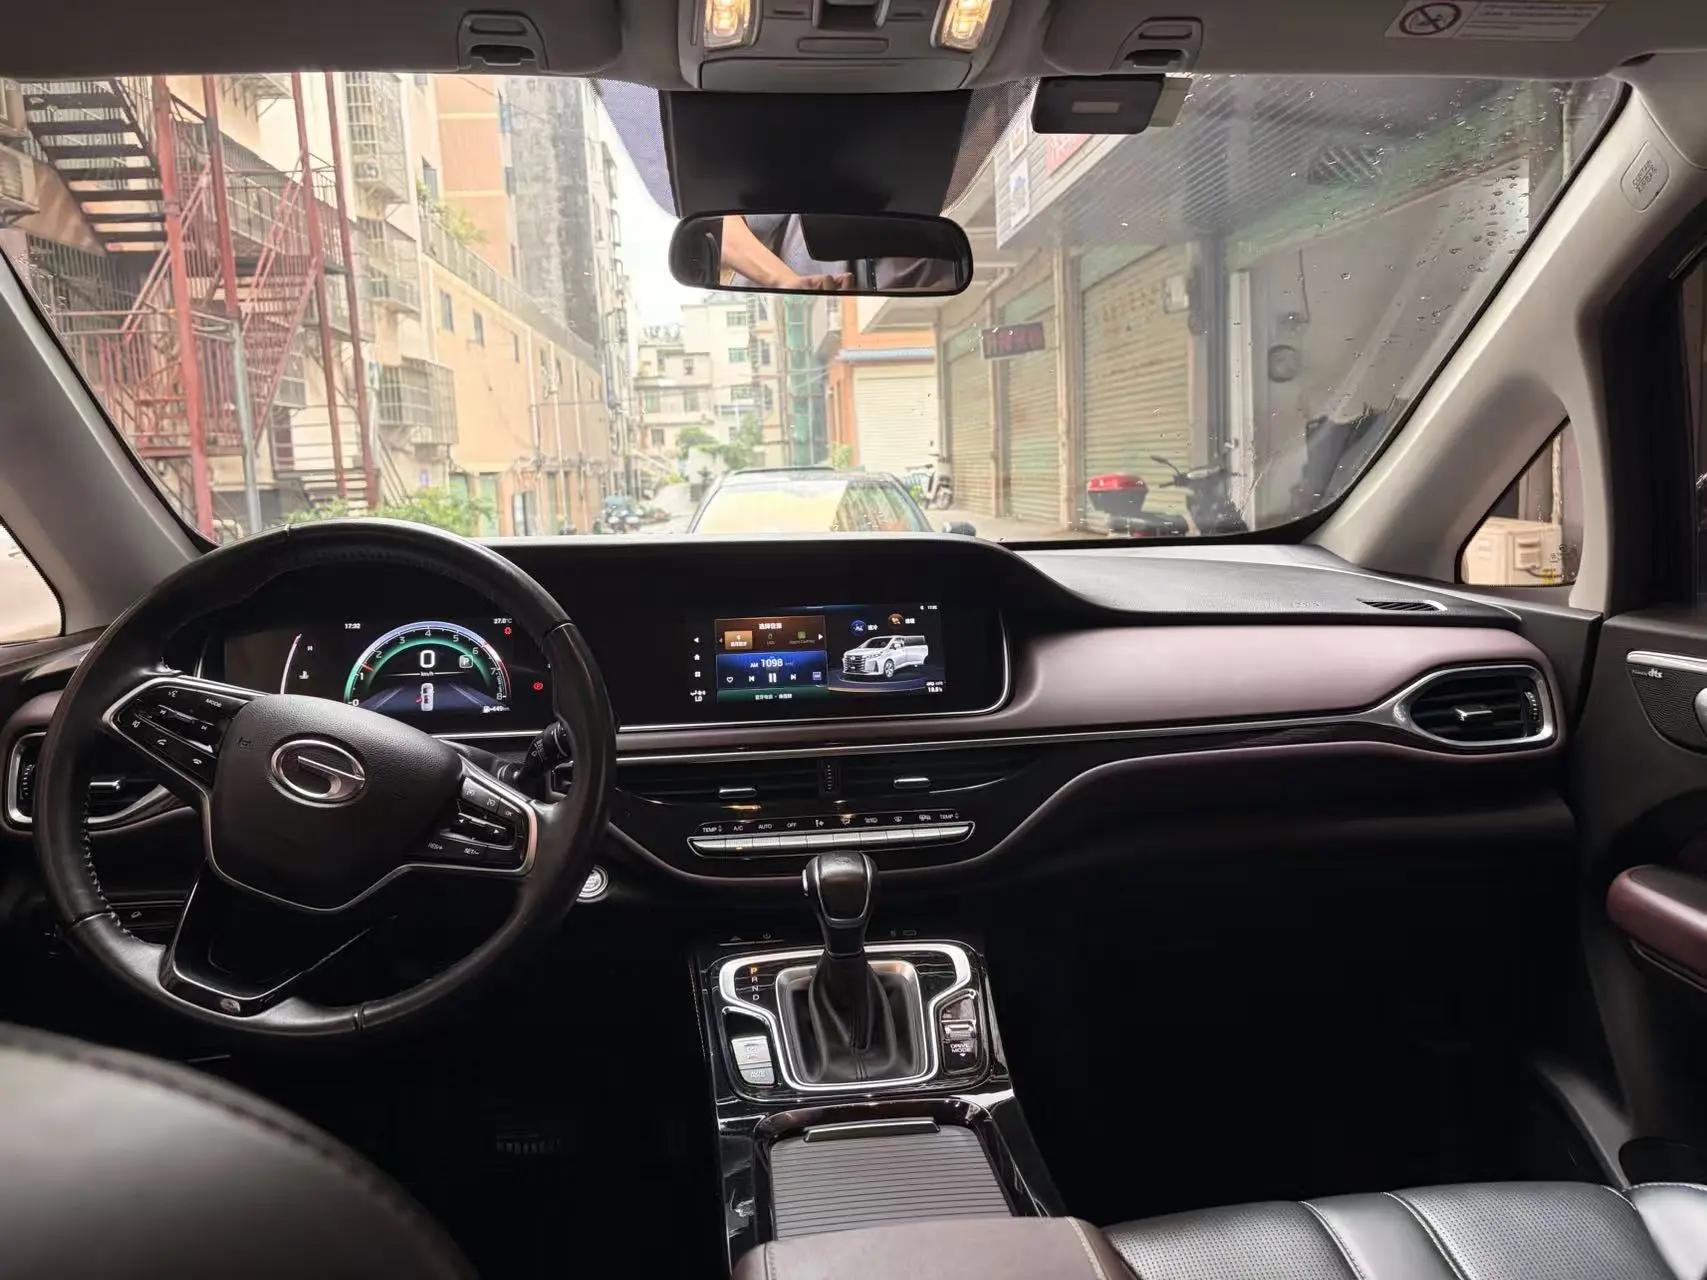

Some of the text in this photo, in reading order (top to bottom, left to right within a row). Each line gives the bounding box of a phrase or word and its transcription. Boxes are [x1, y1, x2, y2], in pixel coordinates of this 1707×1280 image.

[420, 650, 435, 668] 0
[761, 658, 783, 667] 1098
[1648, 668, 1663, 678] dts
[206, 698, 222, 708] MODE
